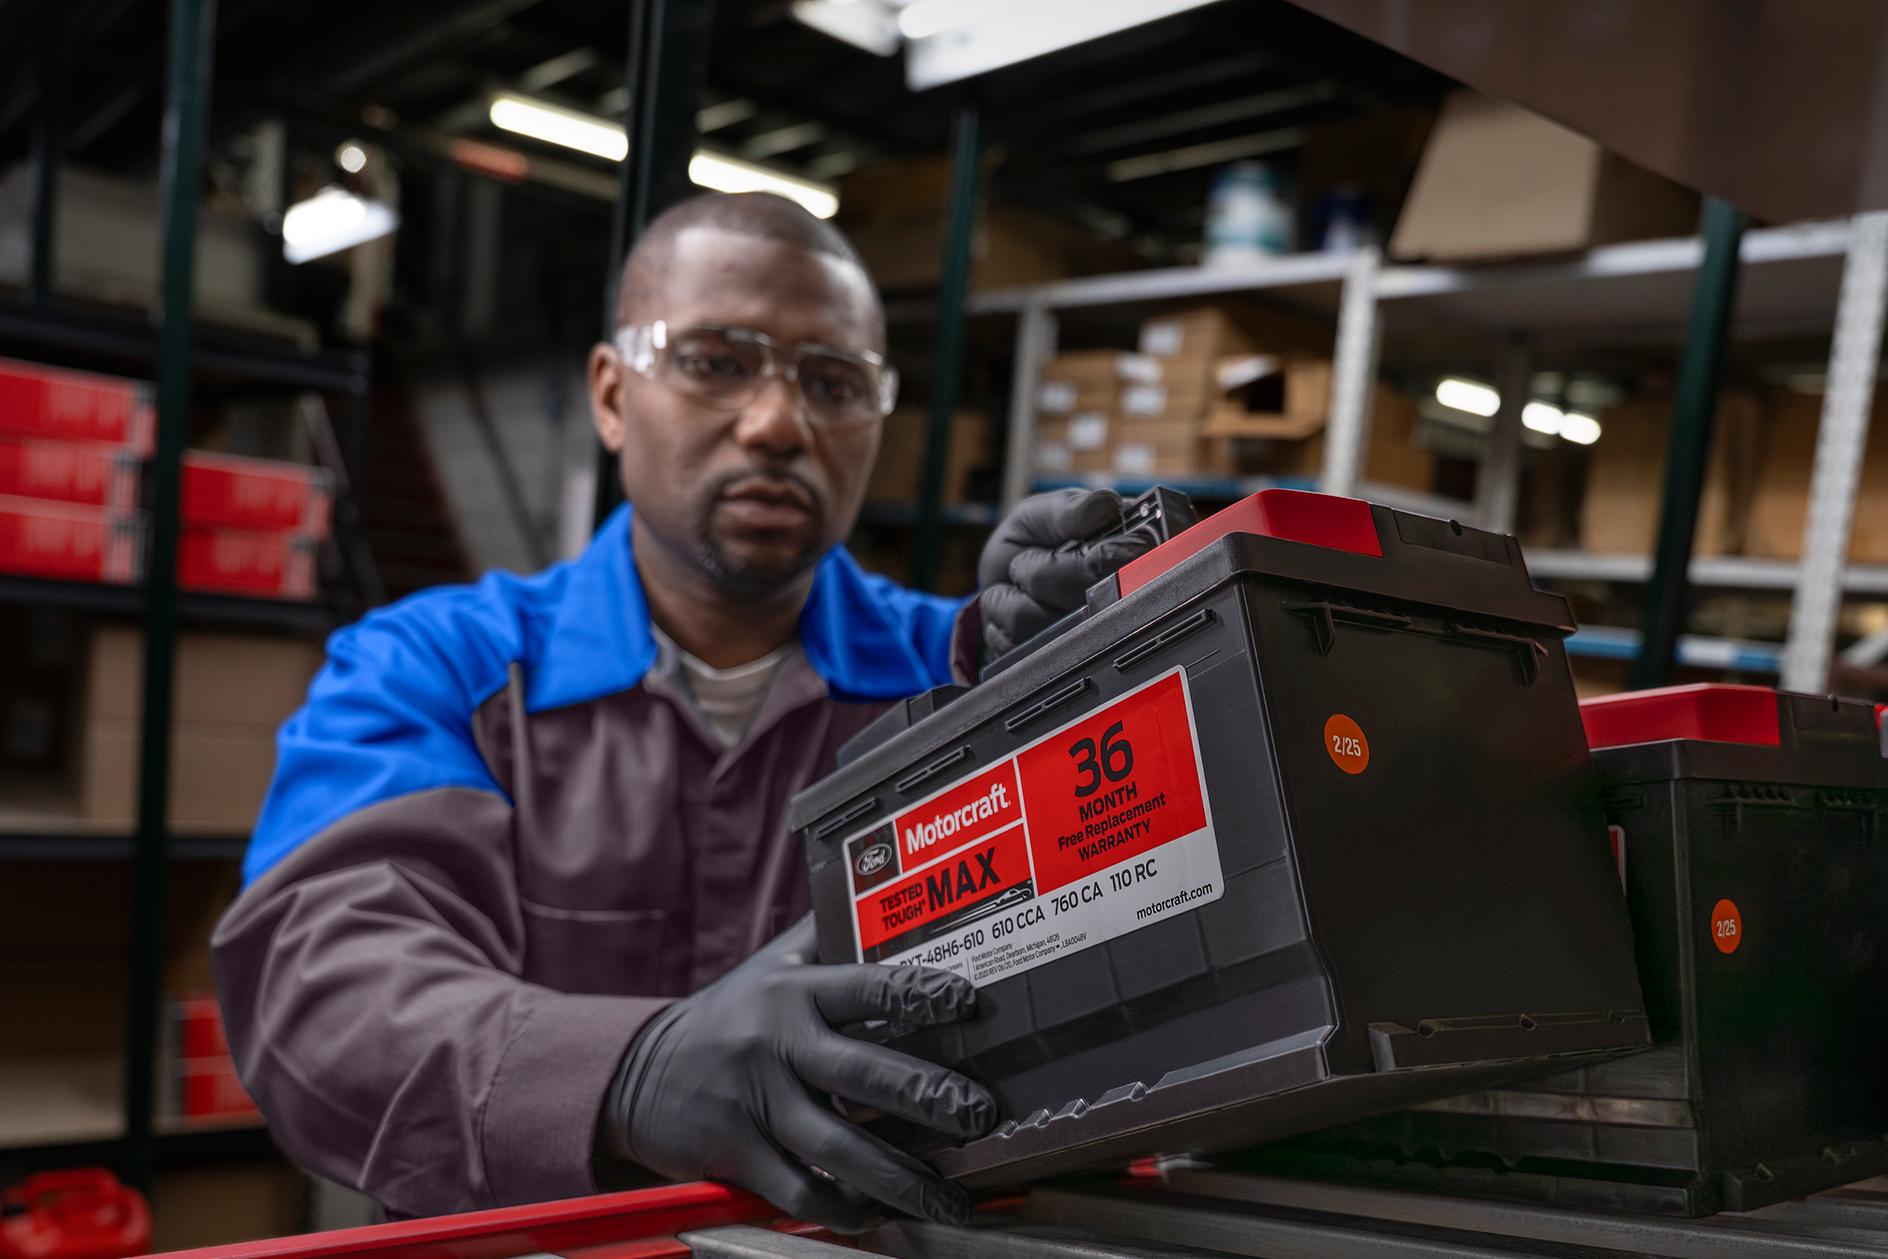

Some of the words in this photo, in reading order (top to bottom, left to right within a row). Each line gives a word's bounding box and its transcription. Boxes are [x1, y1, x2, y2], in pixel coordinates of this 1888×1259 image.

[1067, 719, 1134, 798] 36
[1332, 734, 1362, 757] 2/25
[906, 783, 1010, 855] Motorcraft
[1057, 830, 1089, 852] Free
[1085, 791, 1167, 839] Replacement
[1079, 781, 1138, 823] MONTH
[1077, 818, 1153, 861] WARRANTY
[880, 882, 923, 913] TESTED
[926, 847, 1001, 912] MAX
[991, 917, 1014, 939] 610
[1016, 904, 1046, 930] CCA
[1050, 891, 1079, 916] 760
[1081, 881, 1104, 904] CA
[1109, 868, 1133, 893] 110
[1134, 858, 1158, 883] RC
[1136, 883, 1214, 921] motorcraft.com
[1716, 918, 1737, 938] 2/25
